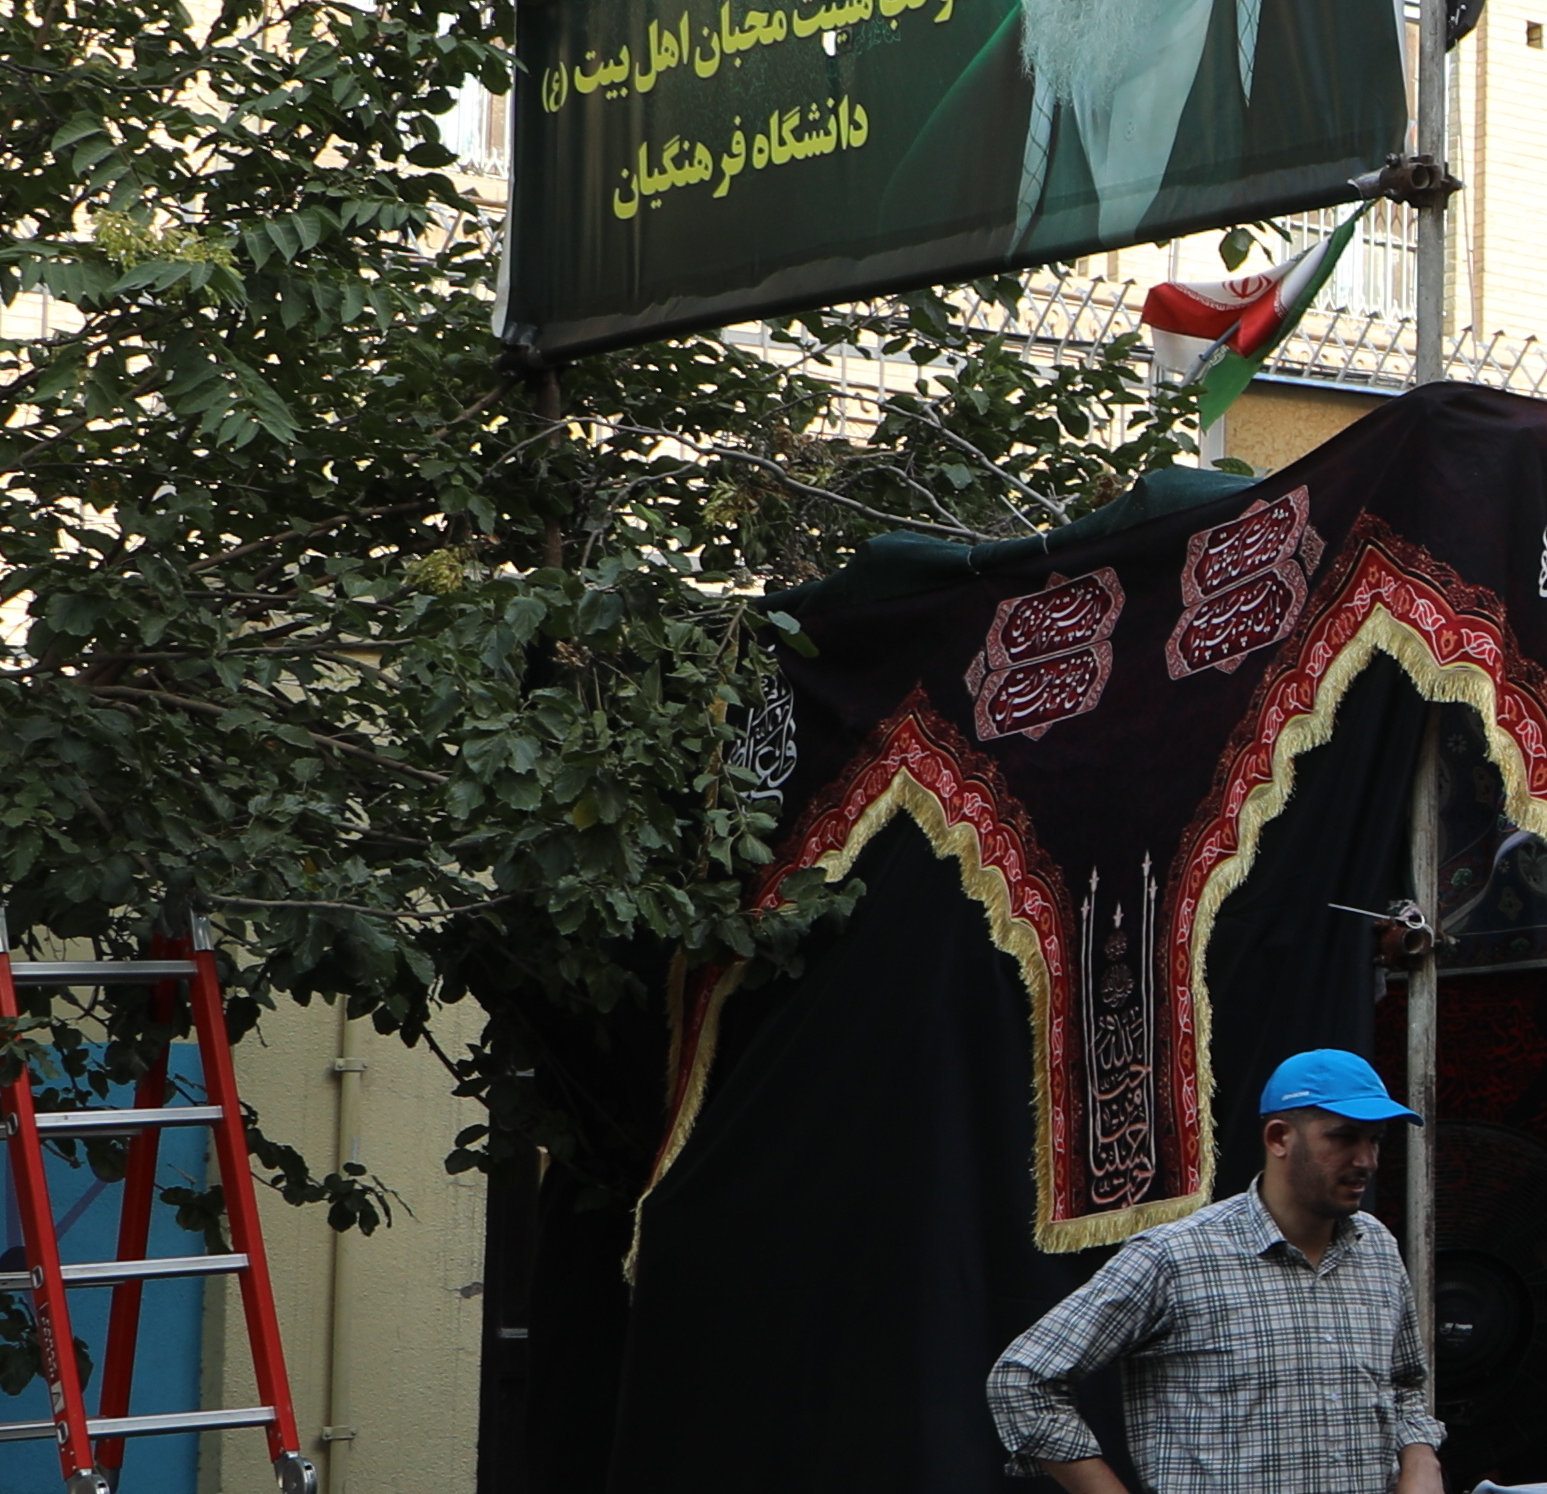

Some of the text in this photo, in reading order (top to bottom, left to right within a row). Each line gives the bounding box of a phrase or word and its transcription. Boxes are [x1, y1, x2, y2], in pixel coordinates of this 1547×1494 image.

[573, 44, 630, 100] بیت
[635, 10, 691, 93] اهل
[694, 0, 788, 78] محبان
[612, 94, 870, 219] دانشگاه فرهنگیان
